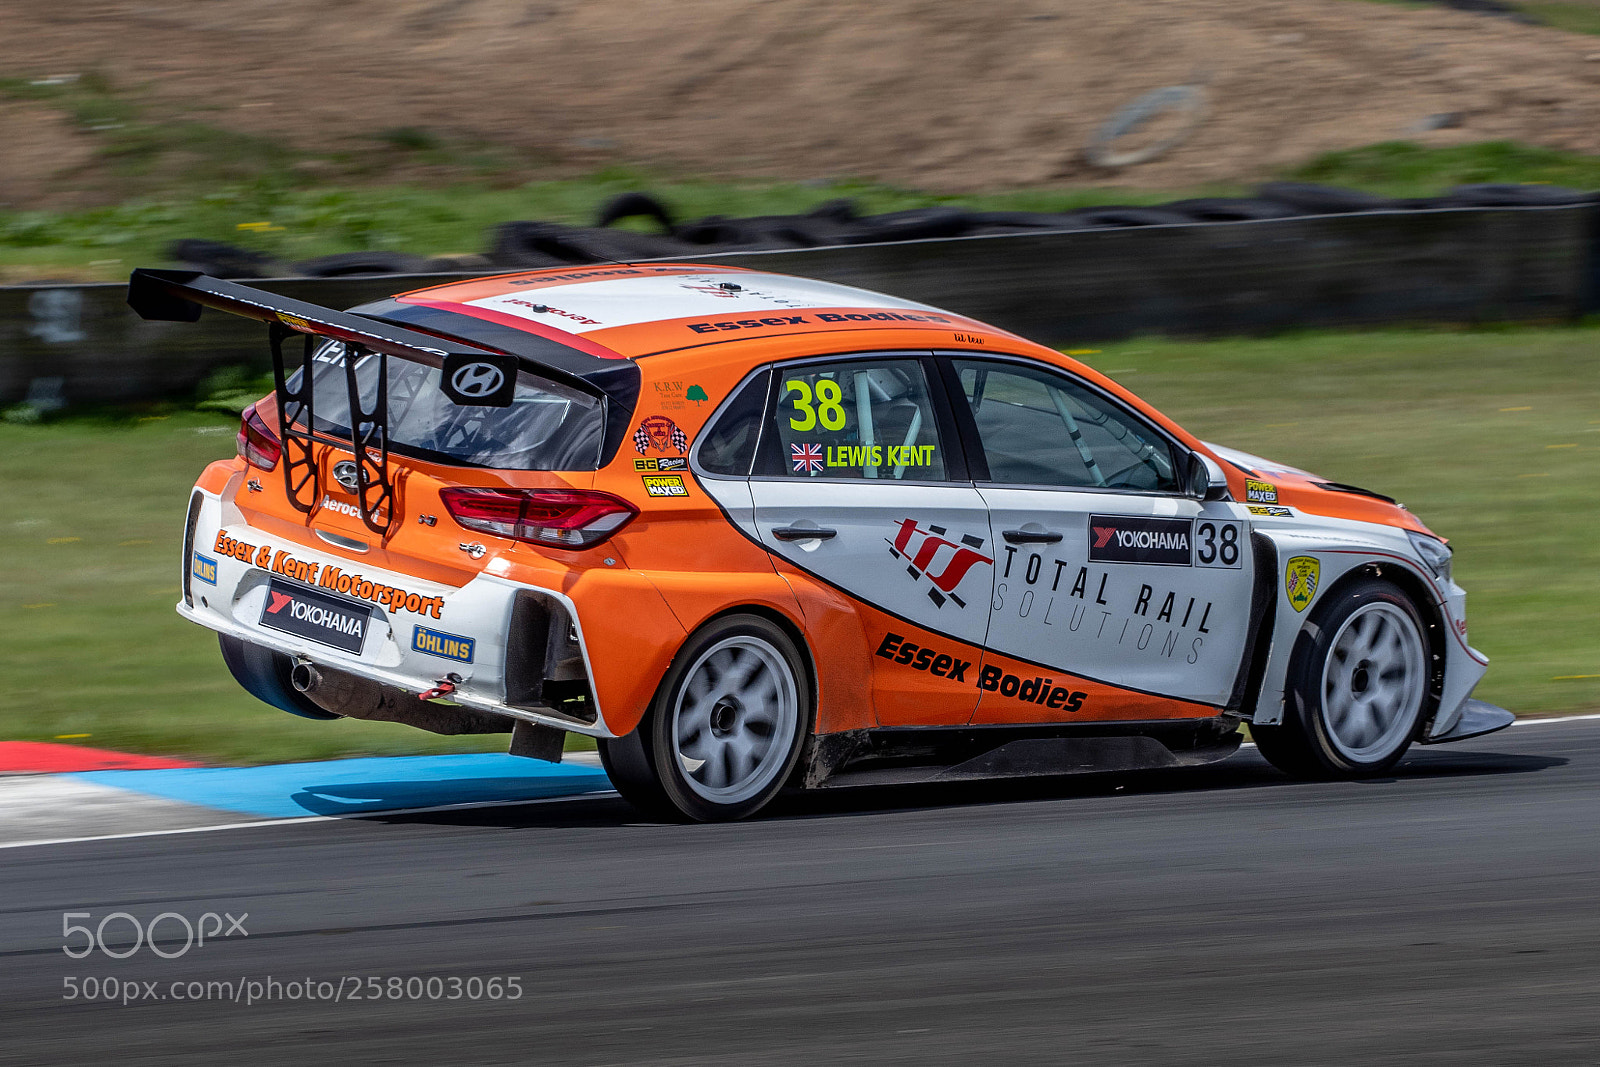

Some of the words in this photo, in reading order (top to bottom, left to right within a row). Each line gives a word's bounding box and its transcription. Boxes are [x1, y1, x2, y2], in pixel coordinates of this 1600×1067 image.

[686, 316, 811, 334] Essex
[814, 312, 952, 324] Bodies
[785, 379, 847, 432] 38
[635, 461, 657, 470] BG
[826, 445, 883, 467] LEWIS
[887, 445, 935, 467] KENT
[646, 478, 681, 487] POWER
[648, 486, 685, 496] MAXED
[1248, 481, 1274, 492] POWER
[1248, 490, 1276, 502] MAXED
[1115, 530, 1189, 550] YOKOHAMA
[1197, 522, 1239, 565] 38
[193, 553, 218, 582] ÖHLINS
[214, 530, 254, 565] Essex
[256, 545, 271, 570] &
[272, 552, 318, 584] Kent
[320, 564, 445, 620] Motorsport
[1004, 545, 1109, 606] TOTAL
[1134, 583, 1212, 634] RAIL
[290, 600, 362, 638] YOKOHAMA
[993, 583, 1203, 665] SOLUTIONS
[416, 628, 470, 660] ÖHLINS
[875, 632, 971, 683] Essex
[976, 663, 1088, 713] Bodies
